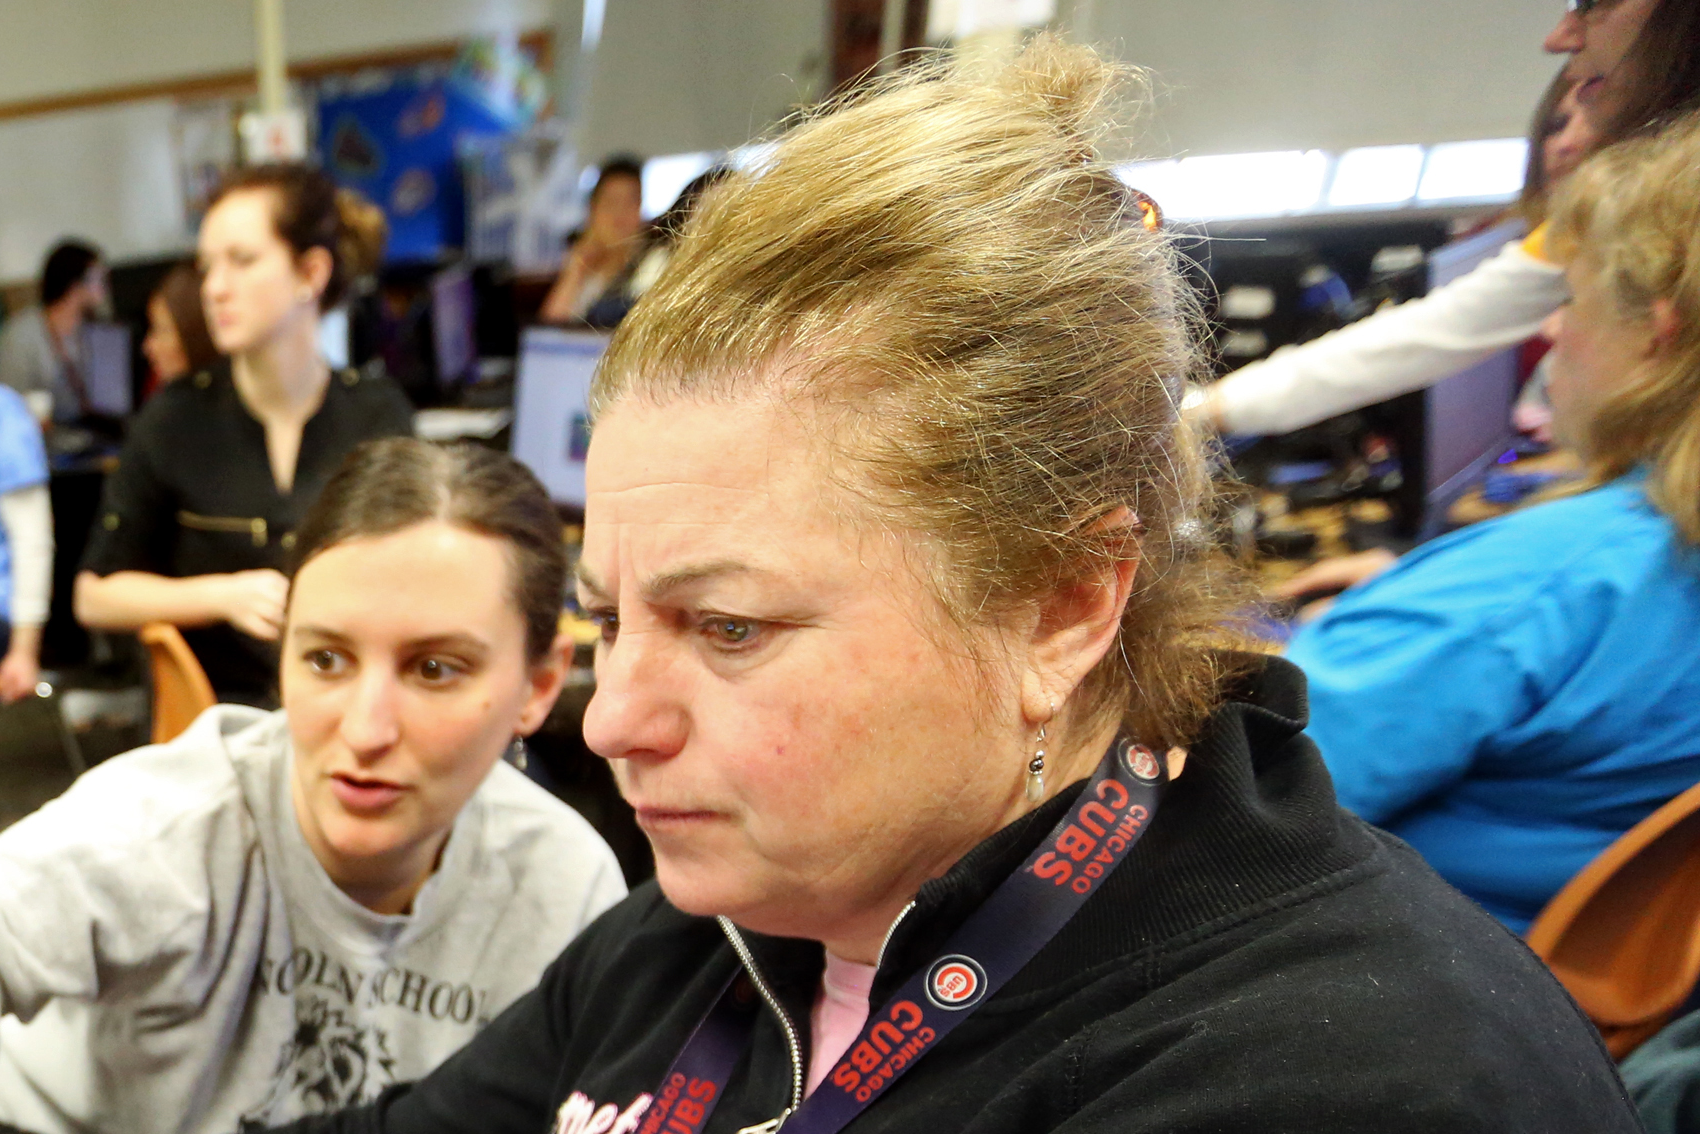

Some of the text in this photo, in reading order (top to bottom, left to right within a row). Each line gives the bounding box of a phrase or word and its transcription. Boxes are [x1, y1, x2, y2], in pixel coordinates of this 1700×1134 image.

[1033, 779, 1129, 886] CUBS
[1071, 805, 1148, 893] CHICAGO
[833, 1000, 924, 1093] CUBS
[856, 1026, 936, 1102] CHICAGO
